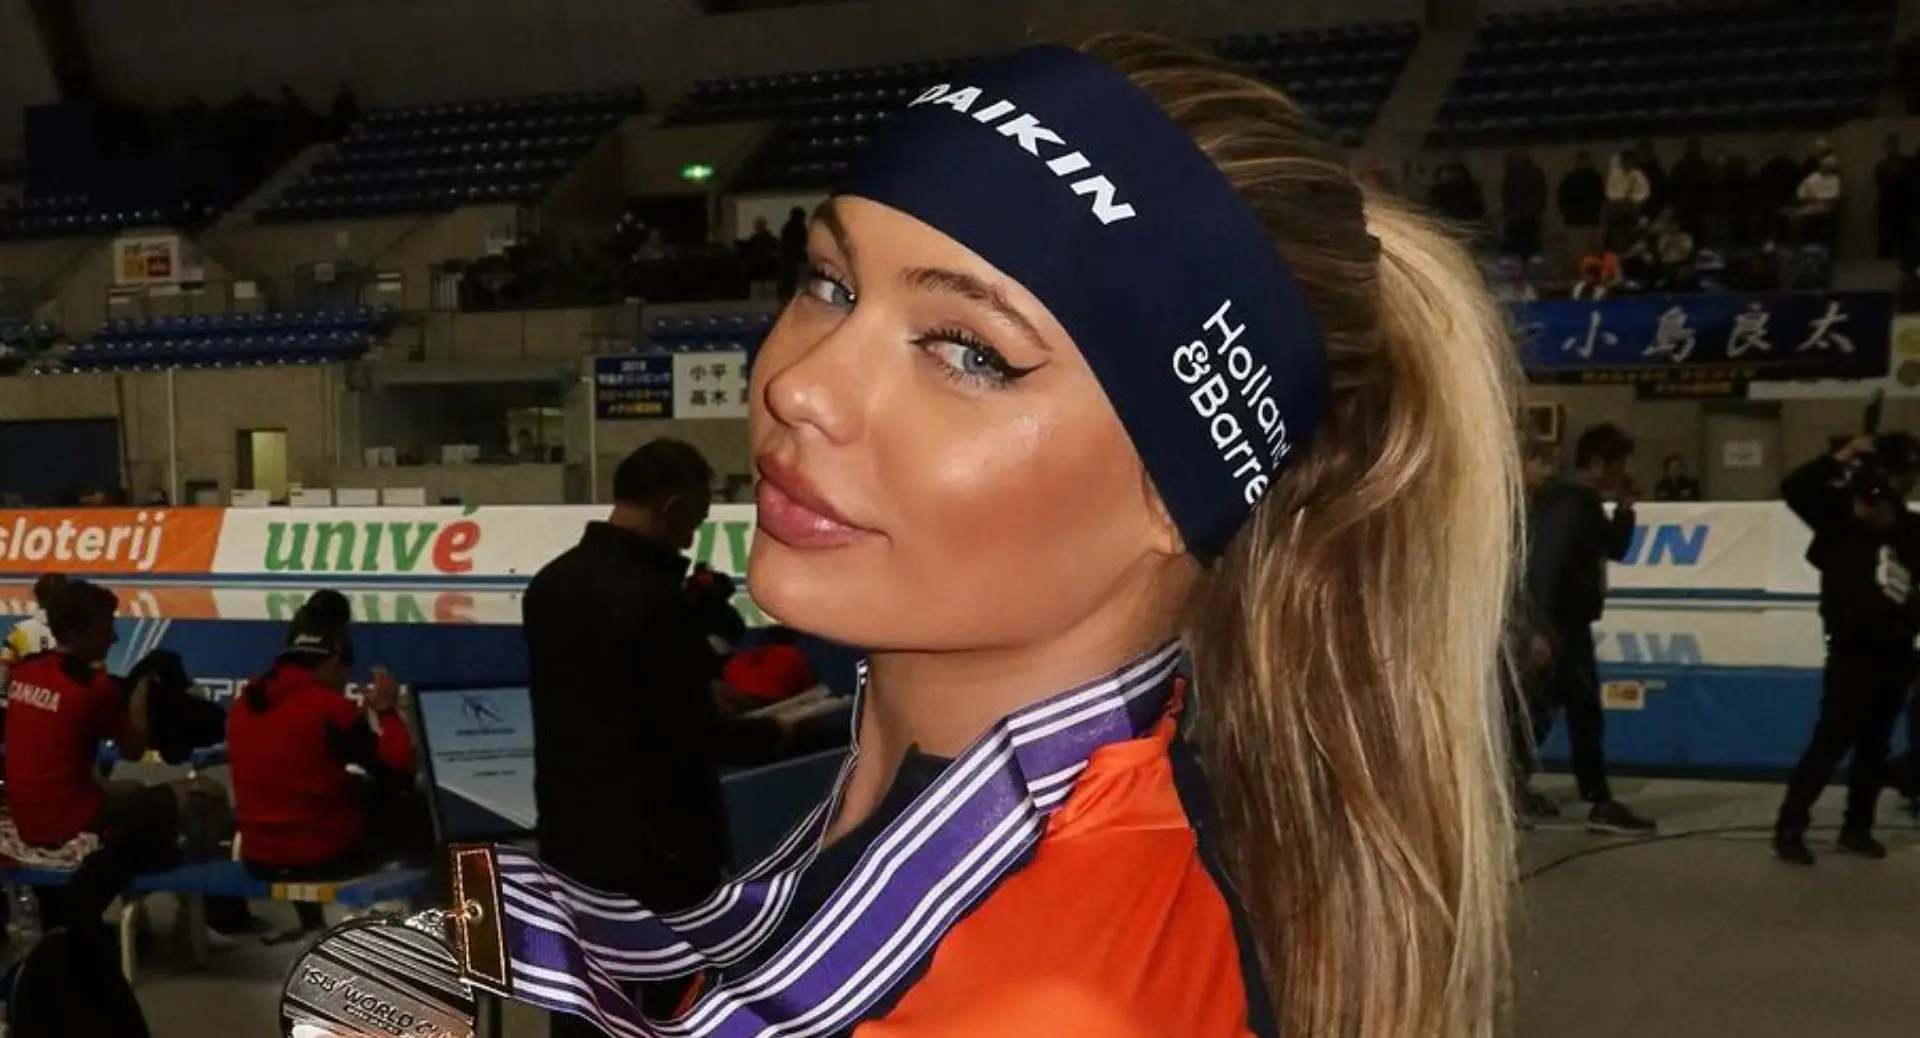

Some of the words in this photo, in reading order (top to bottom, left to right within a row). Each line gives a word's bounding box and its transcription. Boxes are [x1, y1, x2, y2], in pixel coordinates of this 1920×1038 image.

[907, 83, 1137, 225] DAIKIN
[1172, 339, 1270, 505] &Barre
[1202, 299, 1291, 470] Hollan
[264, 504, 481, 573] univé
[345, 984, 413, 1028] WORLD
